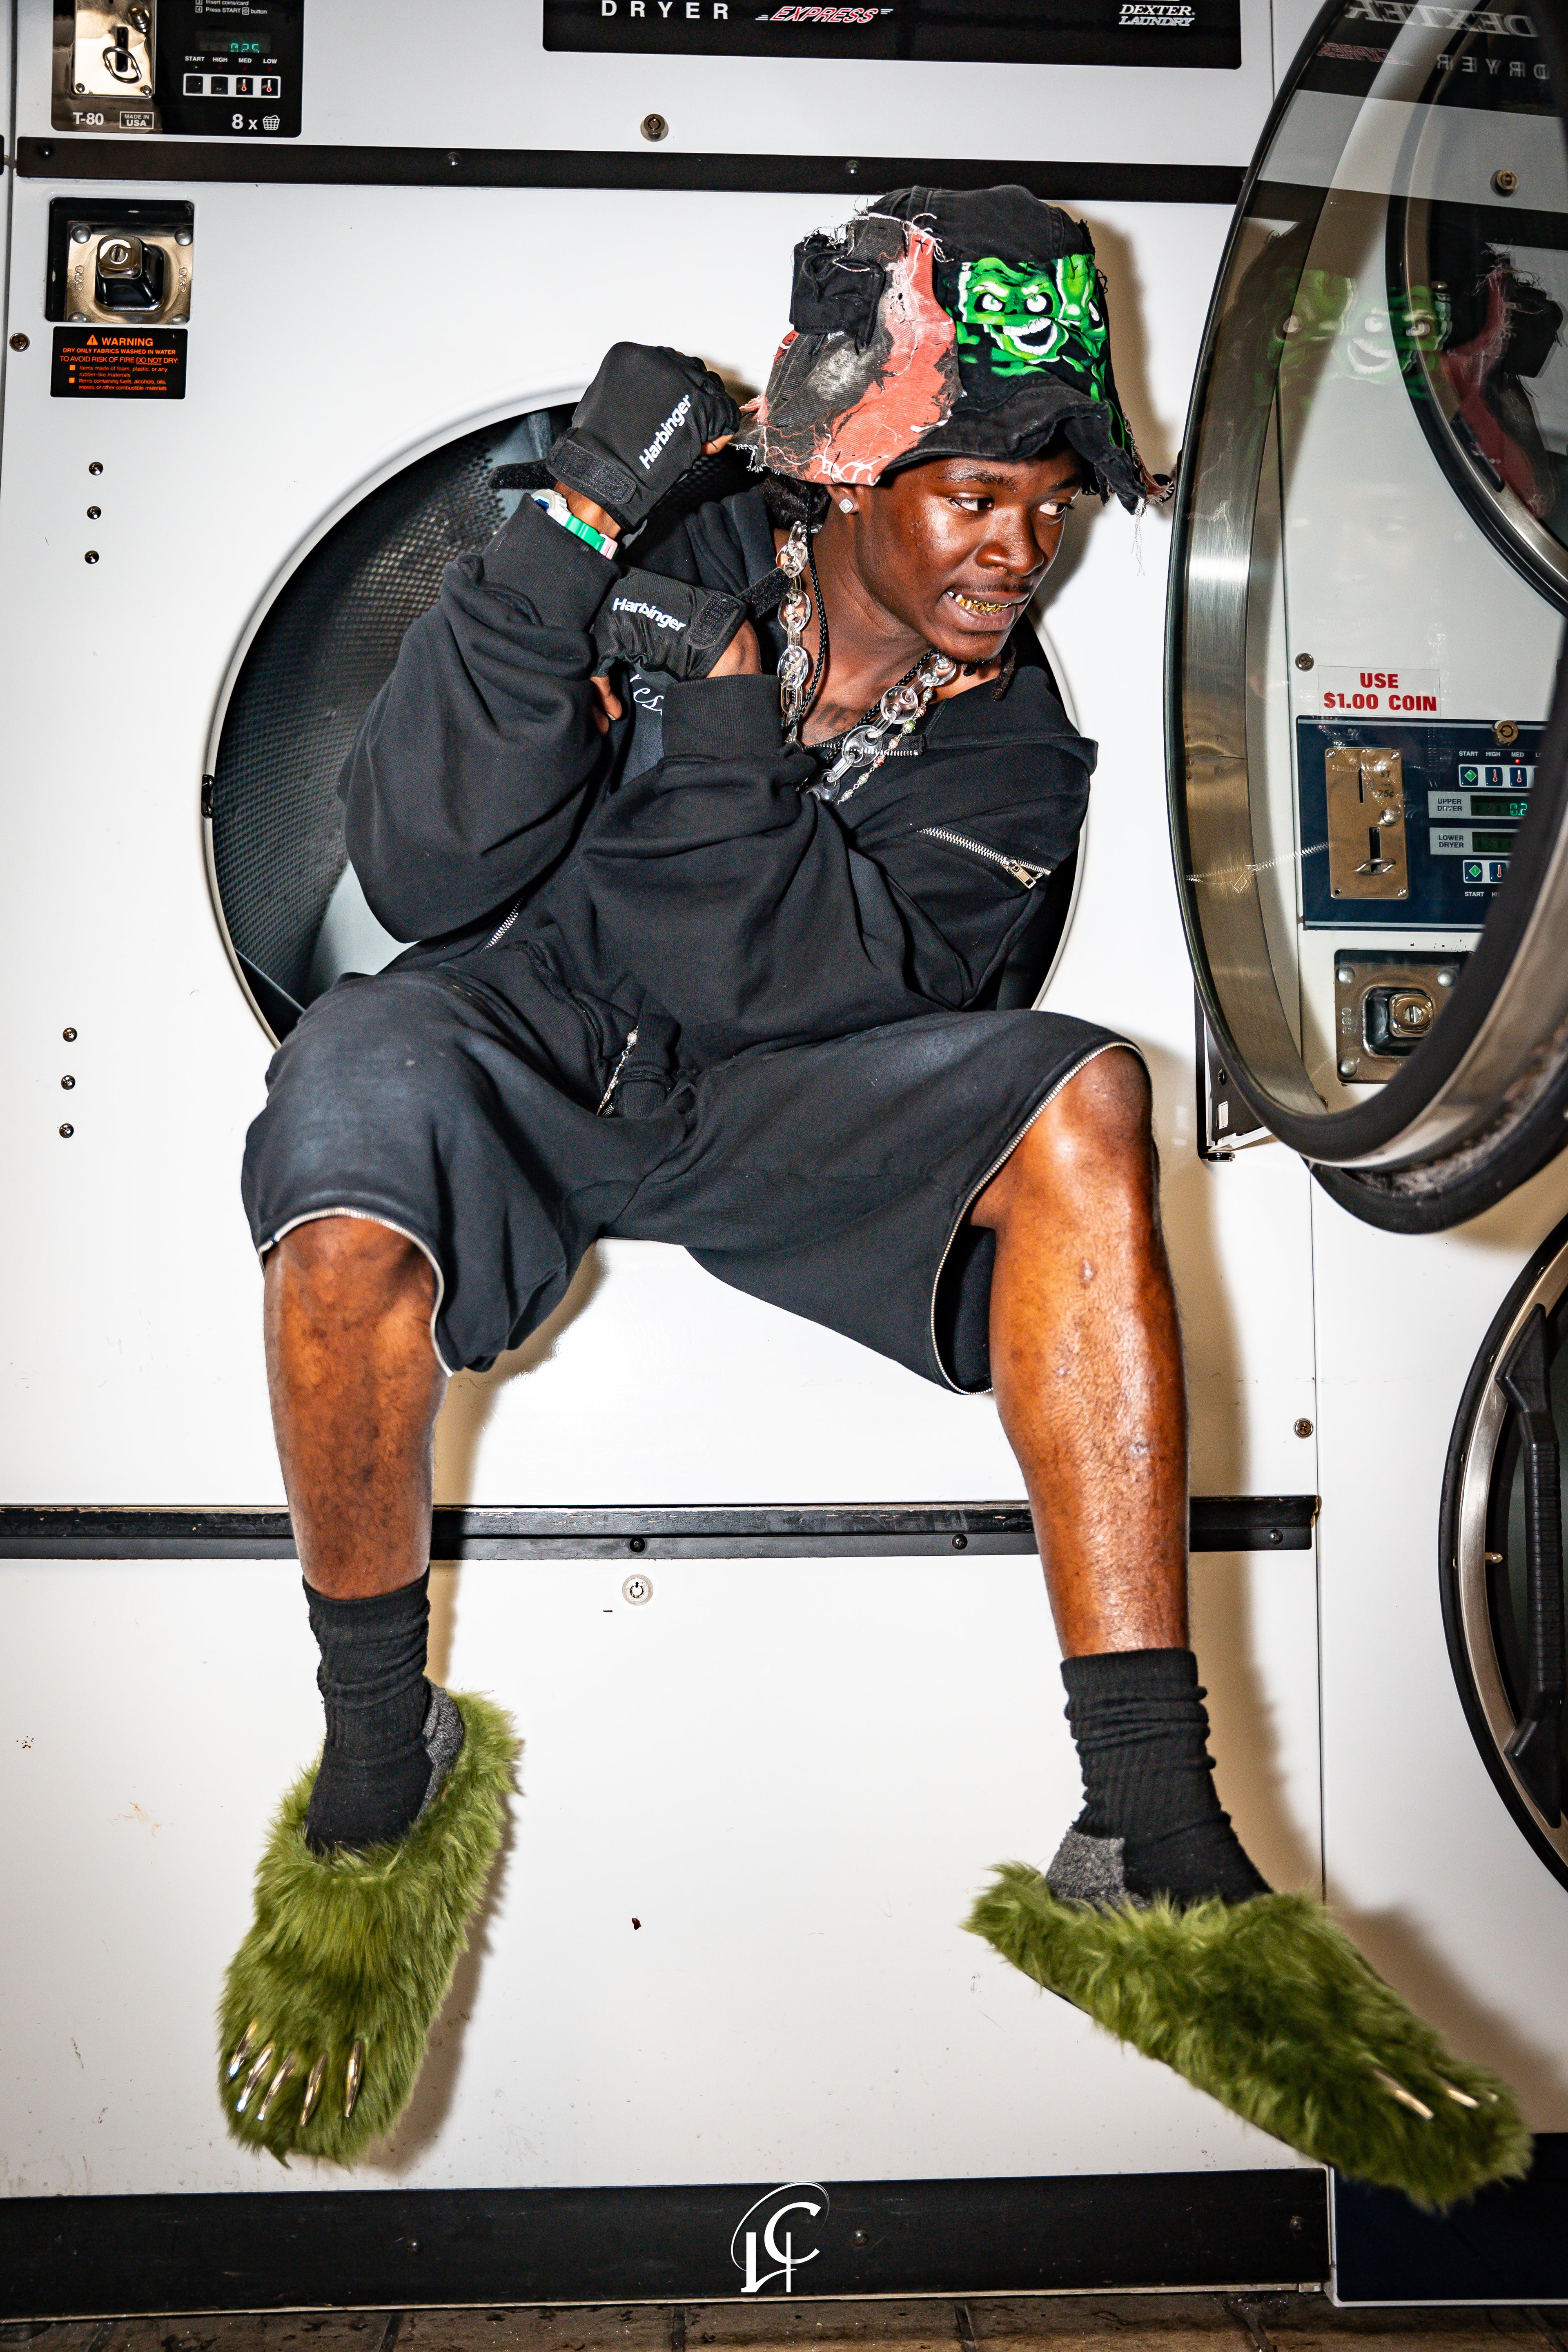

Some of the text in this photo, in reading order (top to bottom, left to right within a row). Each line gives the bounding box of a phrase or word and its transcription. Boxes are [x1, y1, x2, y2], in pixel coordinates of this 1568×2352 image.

[601, 0, 728, 20] DRYER
[770, 6, 879, 23] EXPRESS
[1119, 16, 1195, 26] LAUNDRY
[73, 112, 104, 125] T-80
[232, 114, 243, 129] 8
[101, 337, 154, 346] WARNING
[639, 395, 692, 470] Harbinger
[612, 598, 687, 631] Harbinger
[1360, 673, 1399, 689] USE
[1324, 691, 1437, 711] $1.00 COIN
